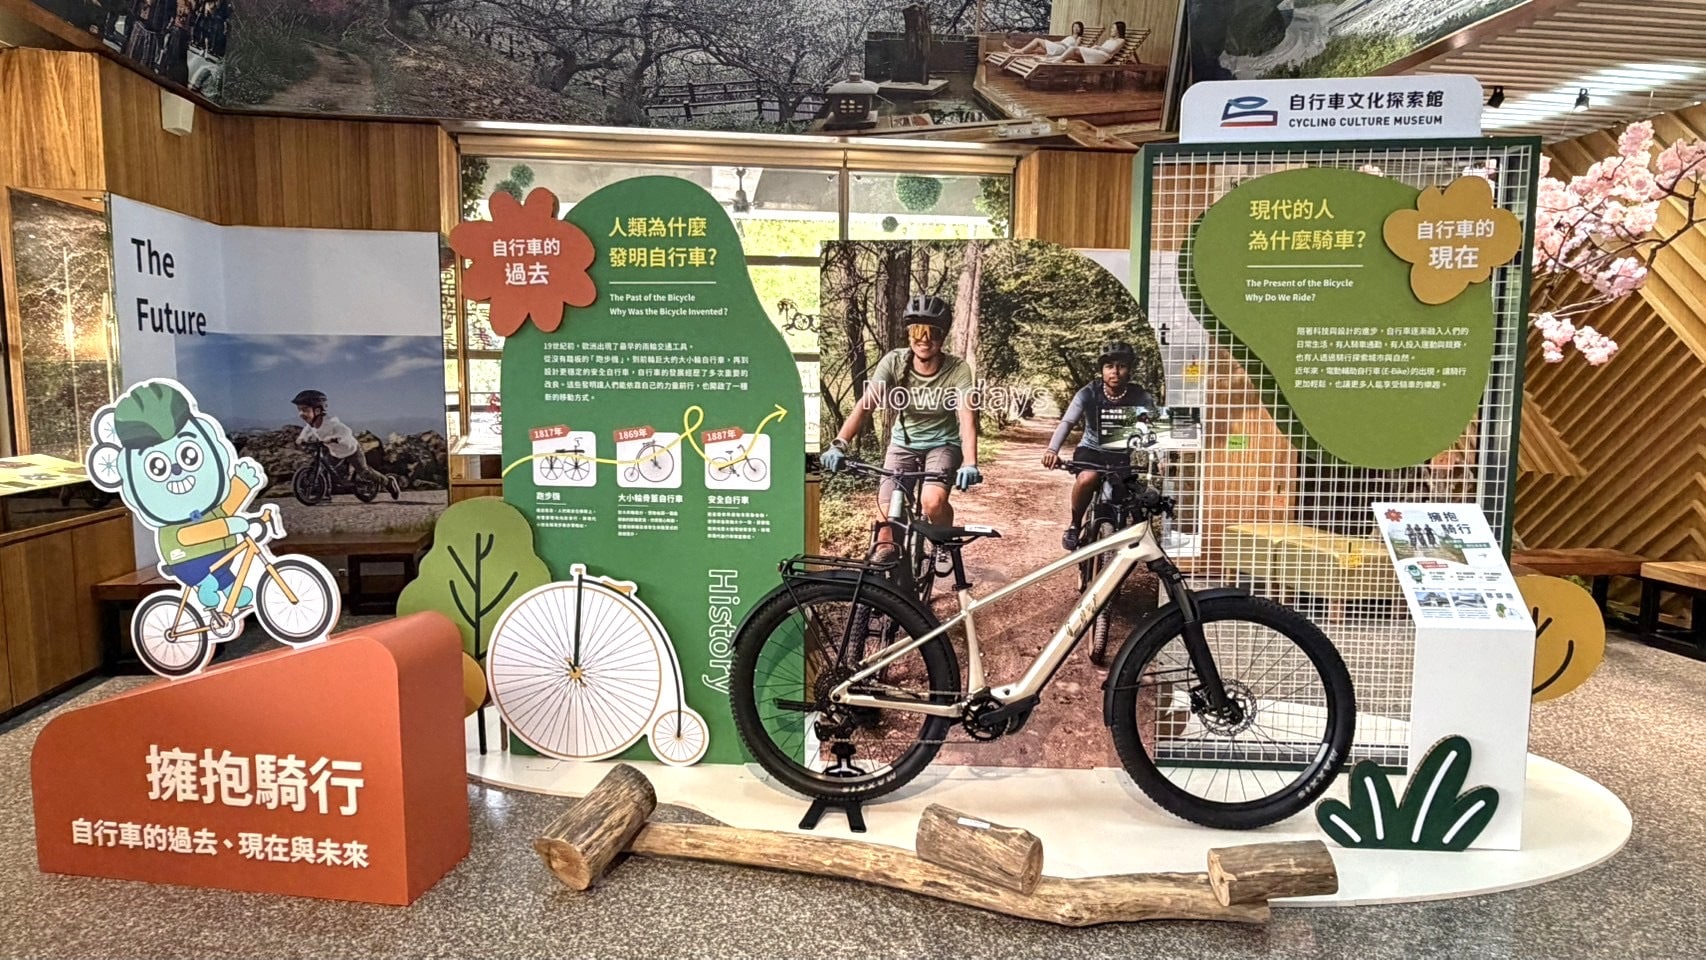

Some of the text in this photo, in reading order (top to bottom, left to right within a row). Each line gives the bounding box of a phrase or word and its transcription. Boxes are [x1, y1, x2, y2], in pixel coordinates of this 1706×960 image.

[1289, 90, 1444, 111] 自行車文化探索館
[1289, 115, 1443, 128] CYCLING CULTURE MUSEUM
[1249, 199, 1334, 220] 現代的人
[609, 216, 707, 238] 人類為什麼
[1417, 218, 1495, 240] 自行車的
[493, 238, 560, 257] 自行車的
[1247, 229, 1367, 251] 為什麼騎車?
[131, 237, 175, 279] The
[608, 246, 718, 268] 發明自行車?
[1428, 245, 1480, 269] 現在
[505, 262, 550, 285] 過去
[1246, 279, 1354, 289] The Present of the Bicycle
[609, 293, 696, 303] The Past of the Bicycle
[1245, 293, 1316, 303] Why Do We Ride?
[137, 297, 208, 337] Future
[609, 307, 627, 317] Why
[628, 307, 644, 316] Was
[645, 307, 659, 316] the
[660, 307, 687, 317] Bicycle
[862, 379, 1051, 418] Nowadays
[534, 427, 564, 439] 1817年
[618, 428, 648, 440] 1869年
[707, 429, 737, 441] 1887年
[707, 495, 750, 505] 安全自行車
[1427, 511, 1459, 523] 擁抱
[1441, 523, 1472, 535] 騎行
[701, 569, 740, 695] History
[145, 744, 365, 817] 擁抱騎行
[71, 817, 370, 869] 自行車的過去、現在與未來
